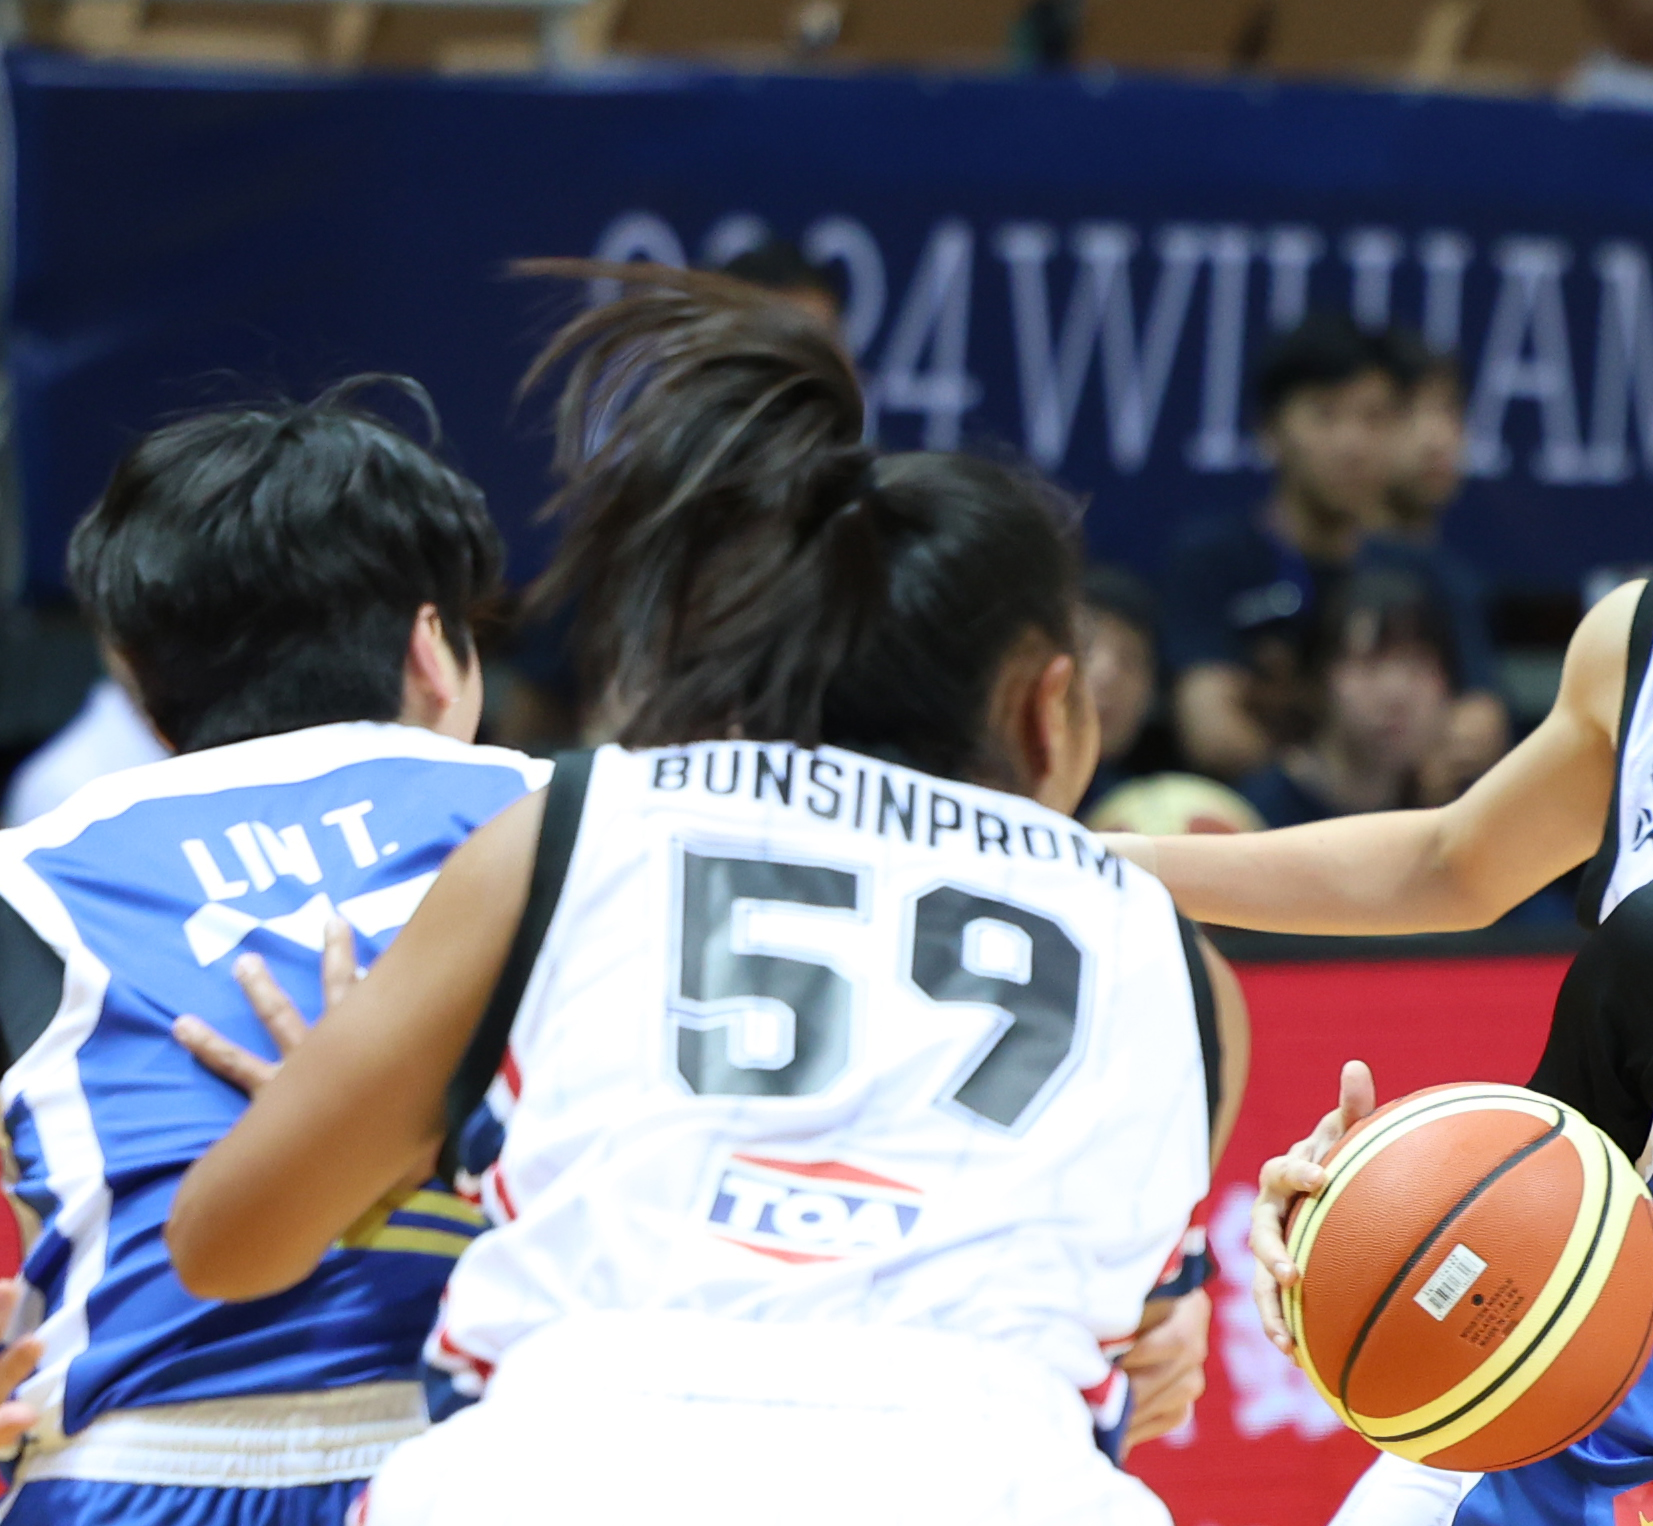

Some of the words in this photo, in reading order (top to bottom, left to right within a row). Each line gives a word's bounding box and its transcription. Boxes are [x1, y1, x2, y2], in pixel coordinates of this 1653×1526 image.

[320, 799, 400, 869] T.
[652, 750, 1124, 888] BUNSINPROM
[671, 838, 1090, 1133] 59
